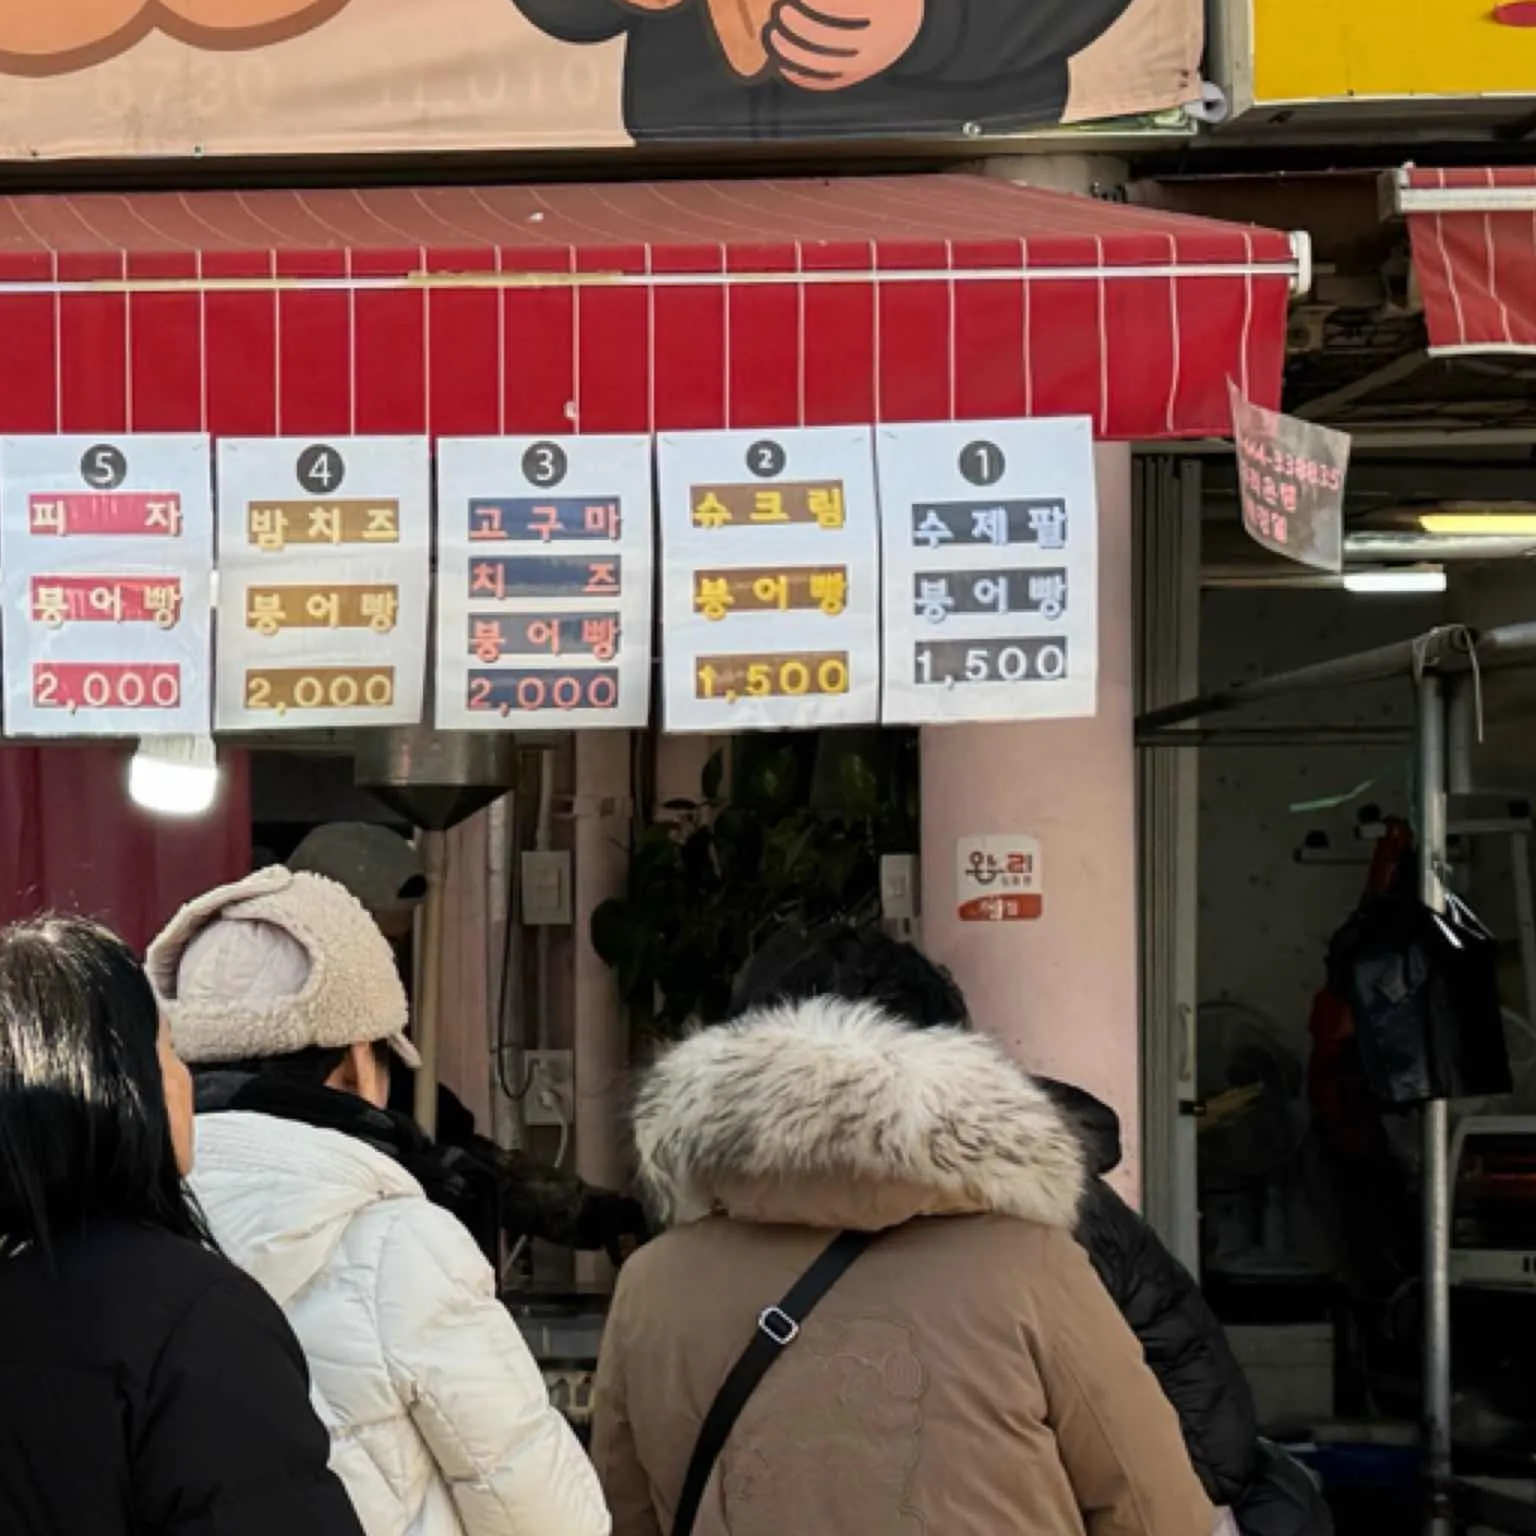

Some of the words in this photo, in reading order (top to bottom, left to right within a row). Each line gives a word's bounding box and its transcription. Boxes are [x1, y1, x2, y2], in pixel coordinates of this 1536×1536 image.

[32, 501, 183, 535] 피자
[251, 506, 399, 551] 밤치즈
[469, 504, 622, 542] 고구마
[693, 488, 843, 530] 슈크림
[471, 563, 619, 598] 치즈
[696, 573, 848, 621] 붕어빵
[914, 576, 1068, 623] 붕어빵
[34, 587, 182, 630] 붕어빵
[247, 593, 398, 636] 붕어빵
[469, 618, 622, 663] 붕어빵
[699, 659, 848, 705] 1,500
[916, 644, 1066, 690] 1,500
[36, 672, 179, 715] 2,000
[248, 675, 392, 717] 2,000
[469, 676, 616, 716] 2,000
